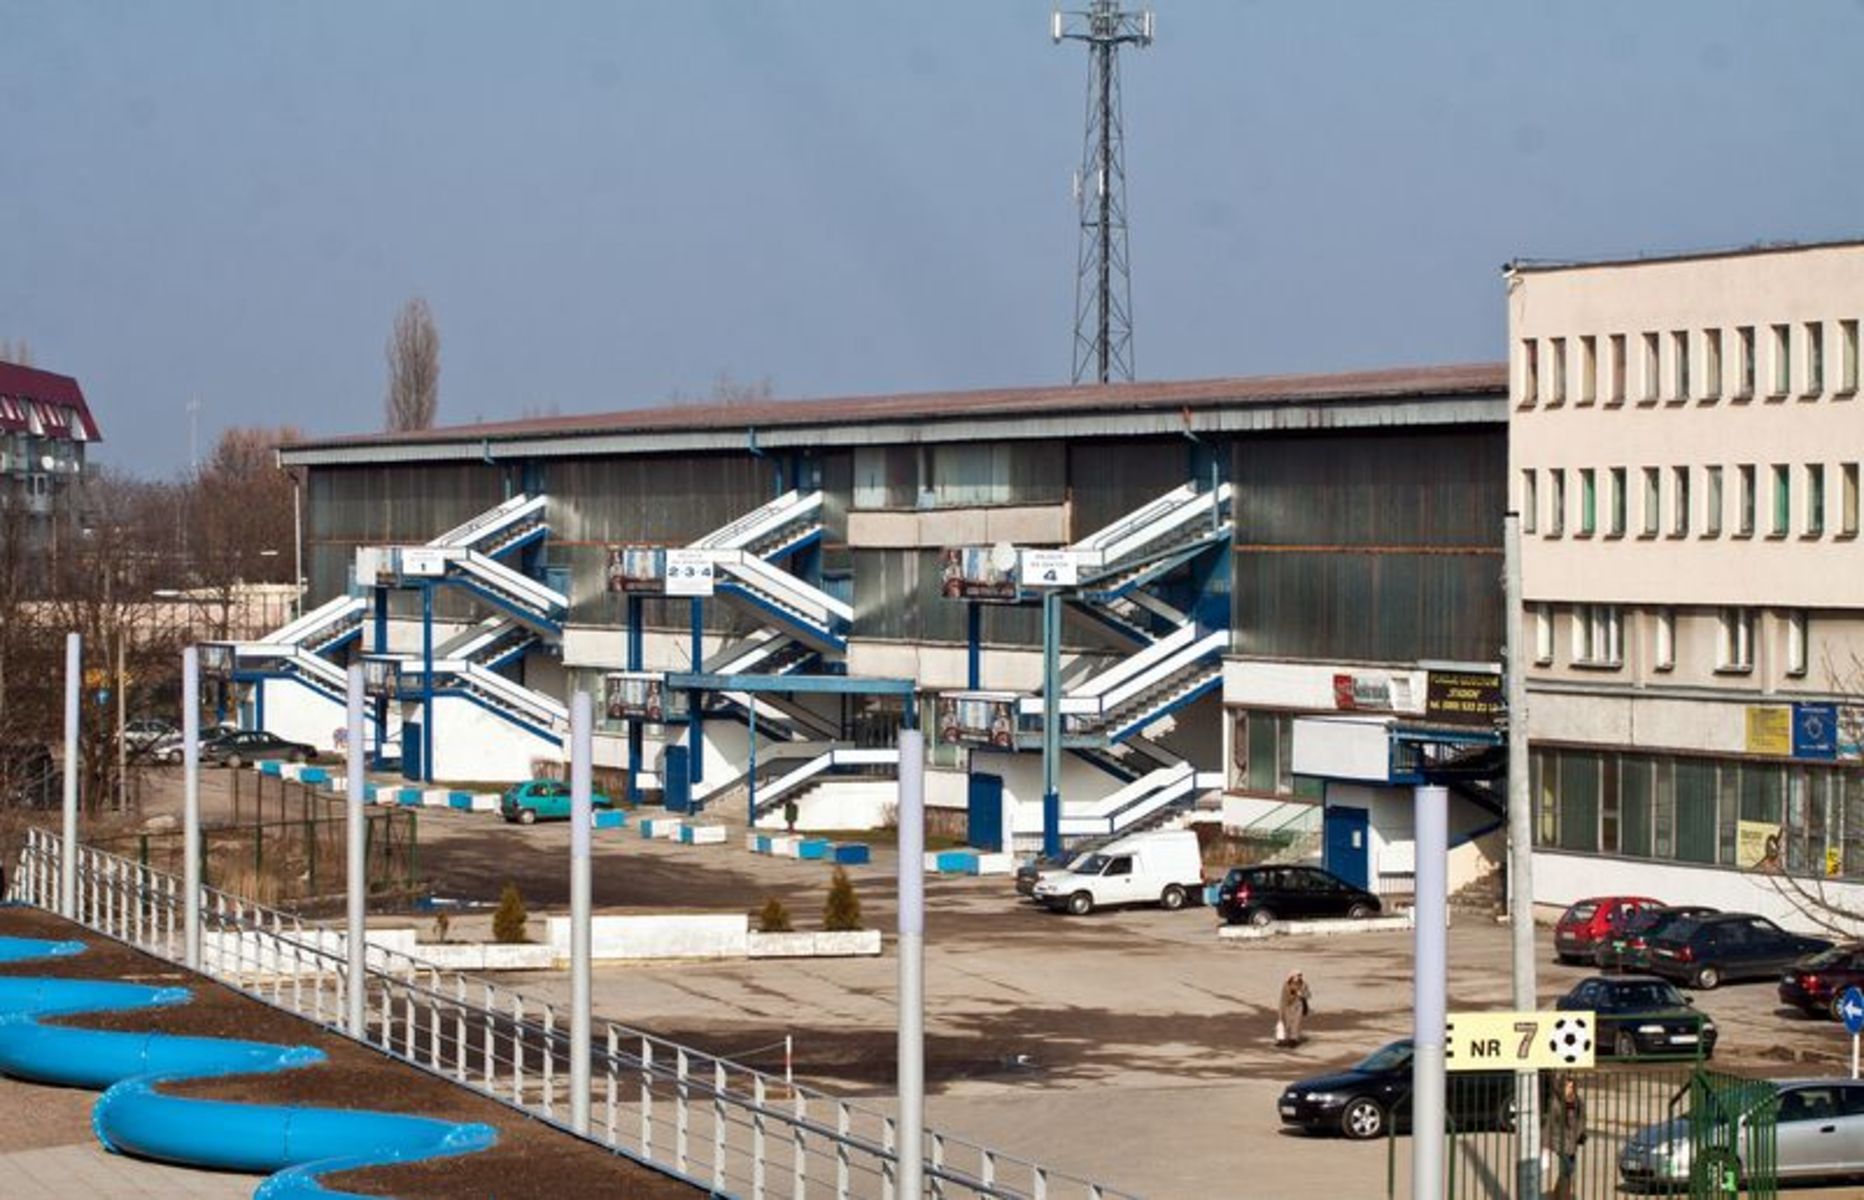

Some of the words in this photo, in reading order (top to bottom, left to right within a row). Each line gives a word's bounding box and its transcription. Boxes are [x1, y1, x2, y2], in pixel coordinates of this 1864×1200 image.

[1043, 569, 1057, 581] 4
[1471, 1039, 1500, 1058] NR
[1514, 1022, 1538, 1059] 7
